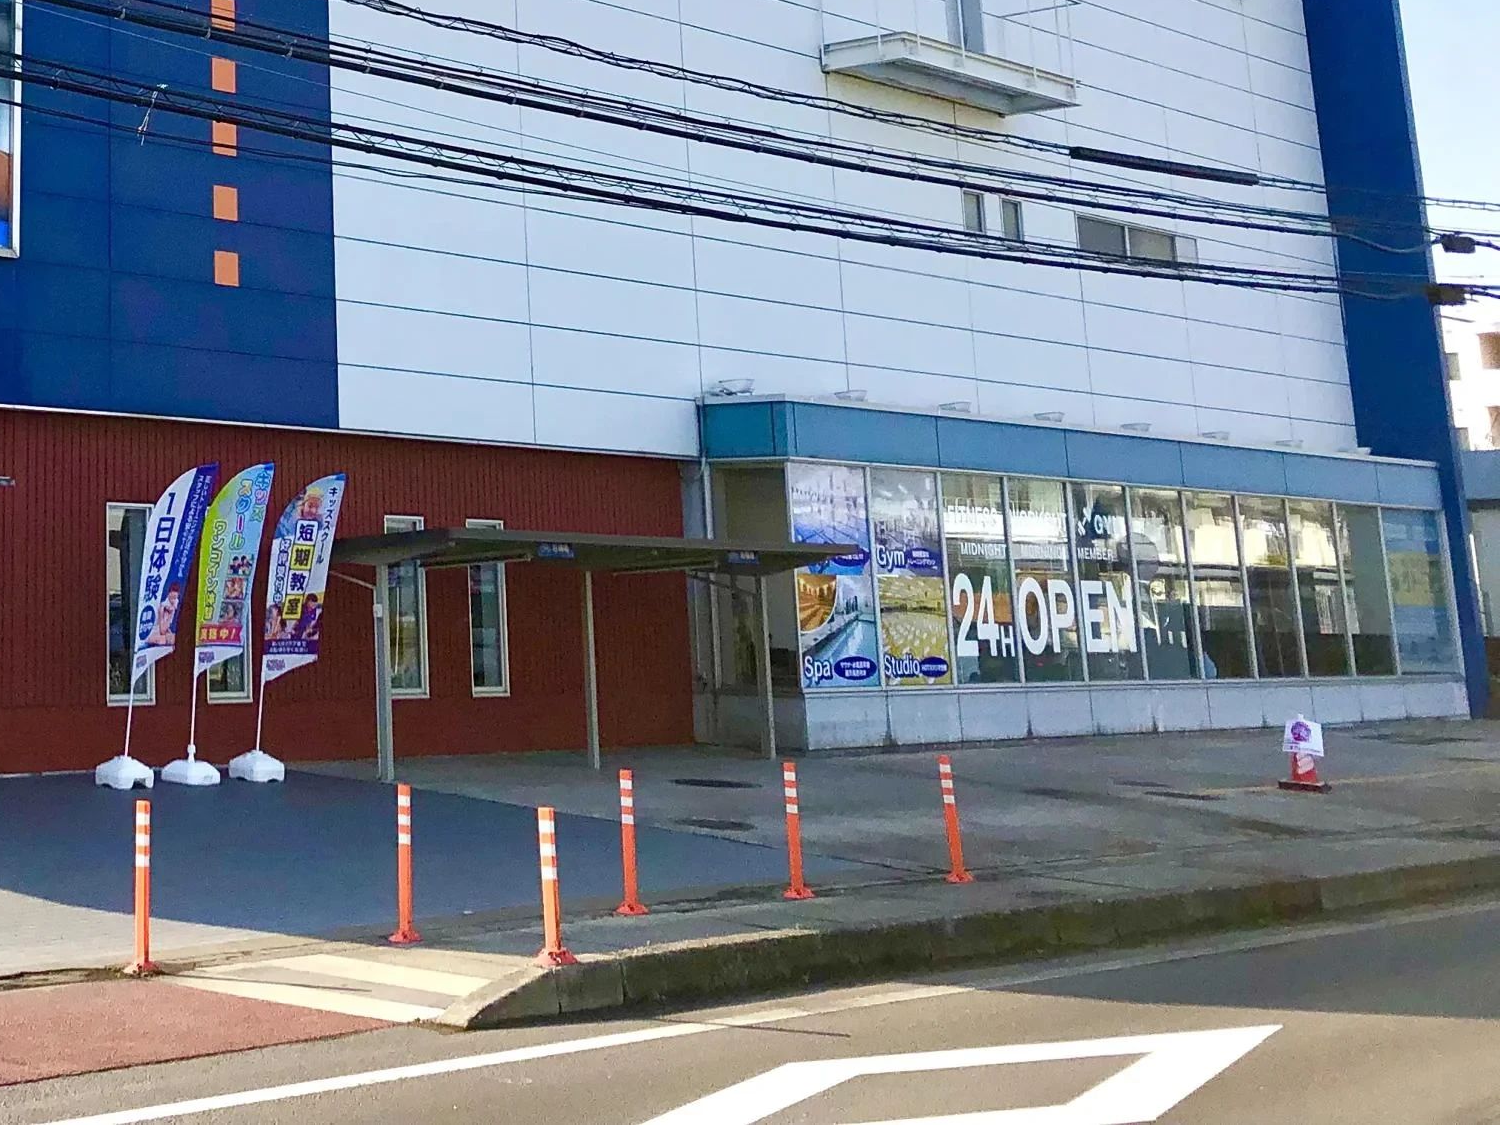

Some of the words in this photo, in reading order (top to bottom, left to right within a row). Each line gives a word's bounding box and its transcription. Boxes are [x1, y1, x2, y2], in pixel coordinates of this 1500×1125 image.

[229, 478, 254, 550] スクール
[250, 472, 270, 523] キッズ
[316, 486, 339, 565] キッズスクール
[285, 523, 315, 616] 短期教室
[876, 544, 905, 570] Gym
[959, 542, 1007, 557] MIDNIGHT
[1076, 546, 1114, 562] MEMBER
[1018, 576, 1138, 656] OPEN
[804, 655, 831, 681] Spa
[885, 653, 921, 676] Studio
